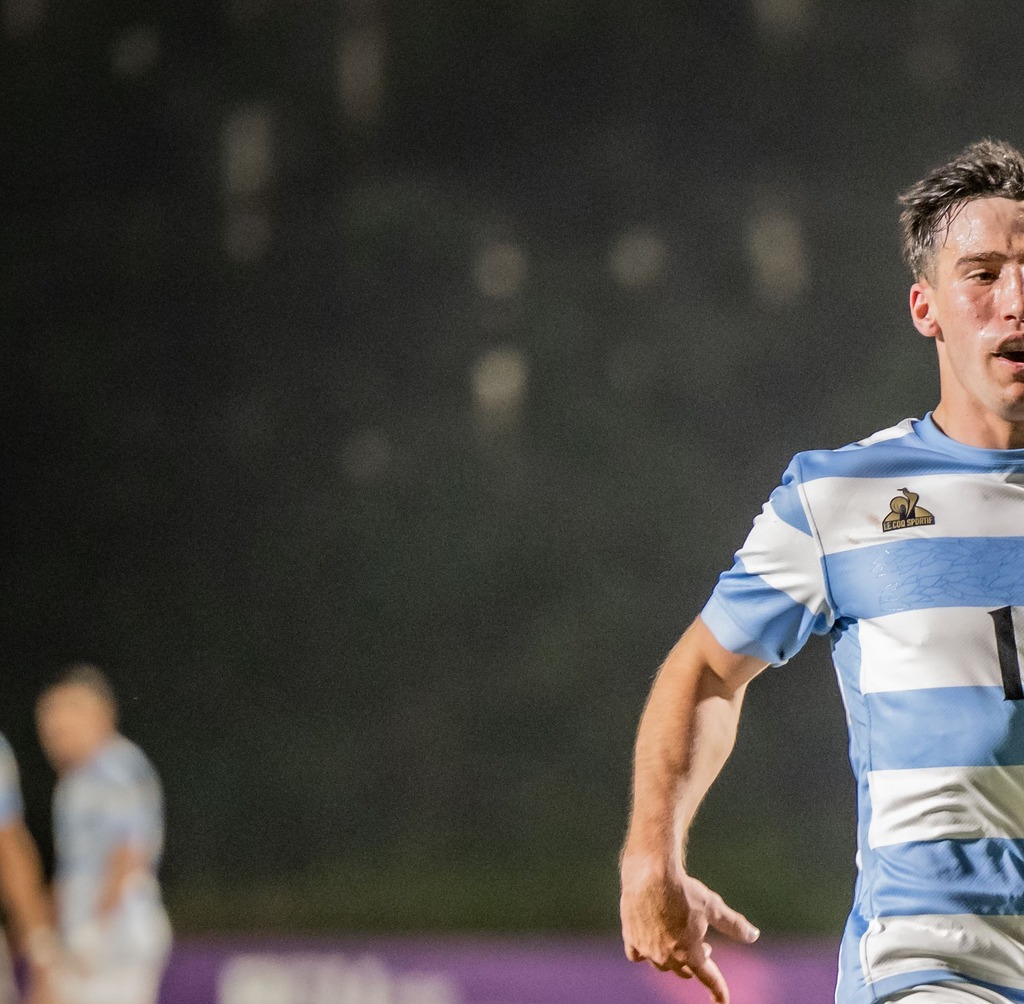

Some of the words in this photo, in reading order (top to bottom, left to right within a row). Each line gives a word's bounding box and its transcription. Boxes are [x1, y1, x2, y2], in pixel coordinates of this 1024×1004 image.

[884, 521, 893, 530] LE
[892, 519, 905, 529] COQ
[906, 517, 933, 527] SPORTIF
